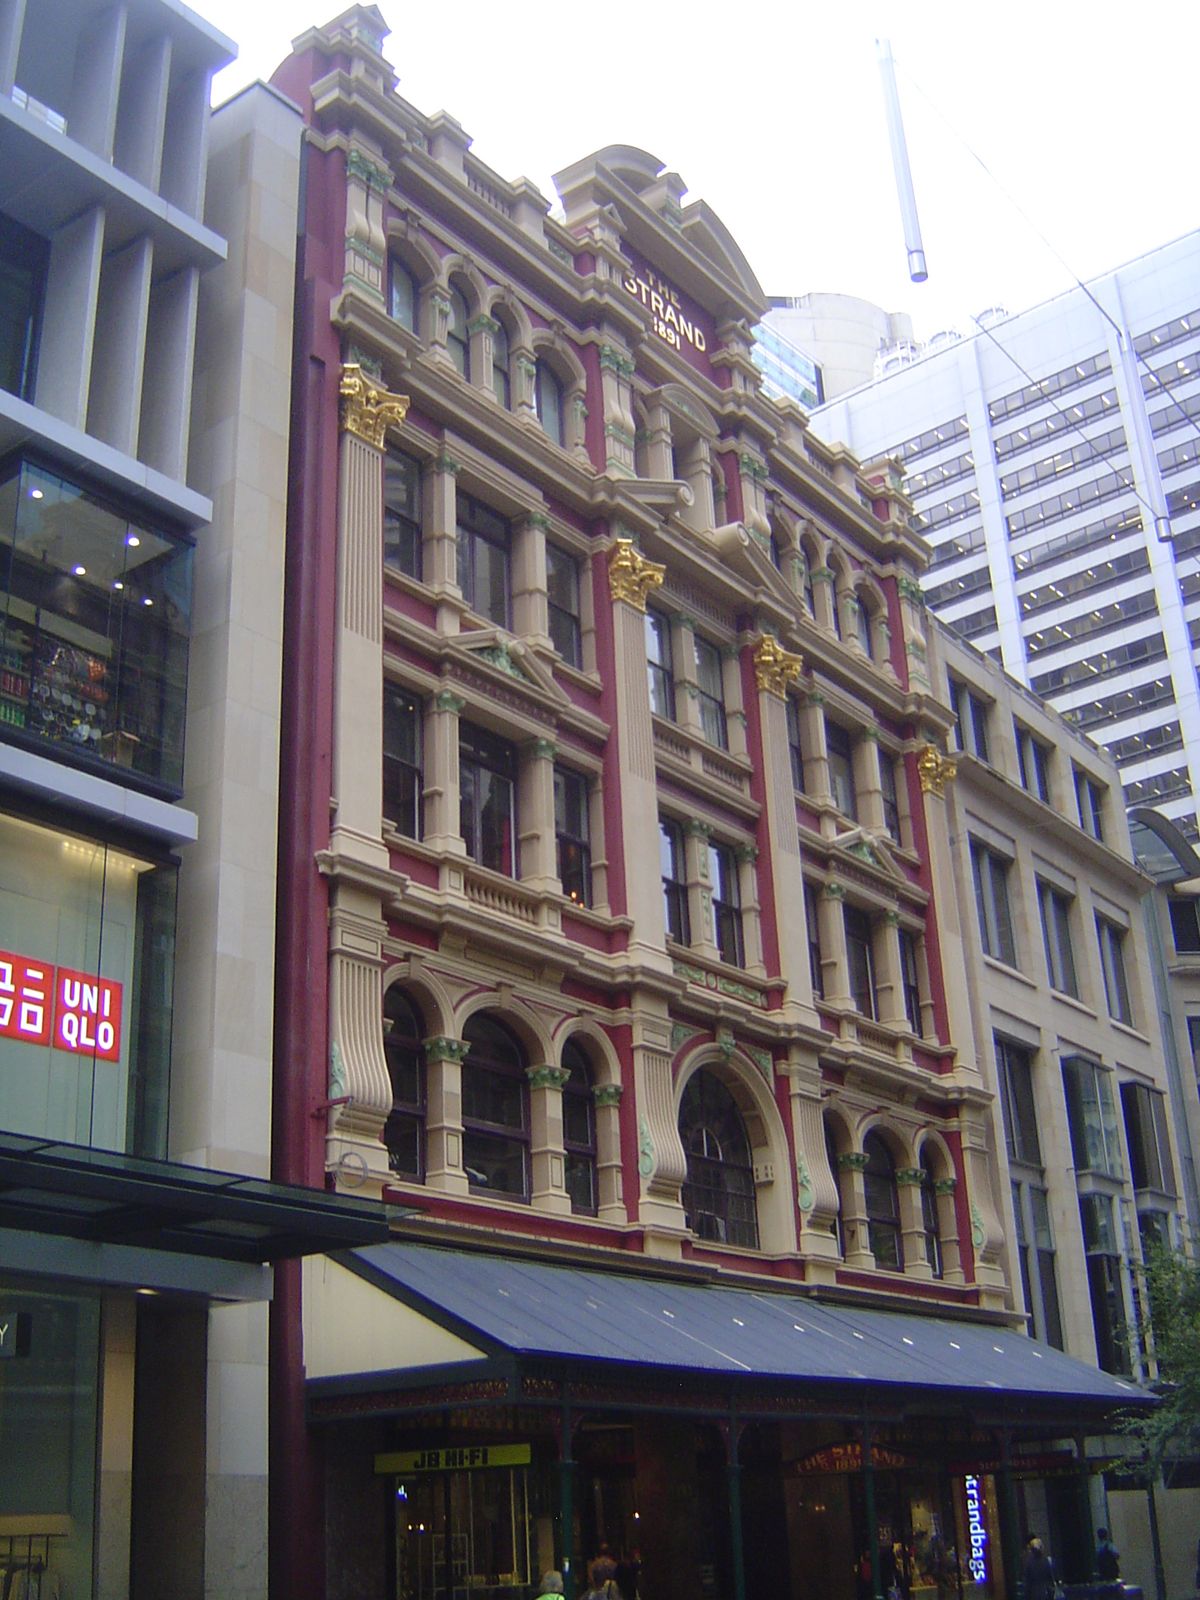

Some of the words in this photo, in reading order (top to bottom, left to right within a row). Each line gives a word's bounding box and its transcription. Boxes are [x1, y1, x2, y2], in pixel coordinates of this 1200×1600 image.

[645, 268, 681, 310] THE
[653, 316, 681, 351] 1891
[63, 978, 111, 1017] UNI
[61, 1012, 115, 1050] QLO
[413, 1451, 440, 1468] JB
